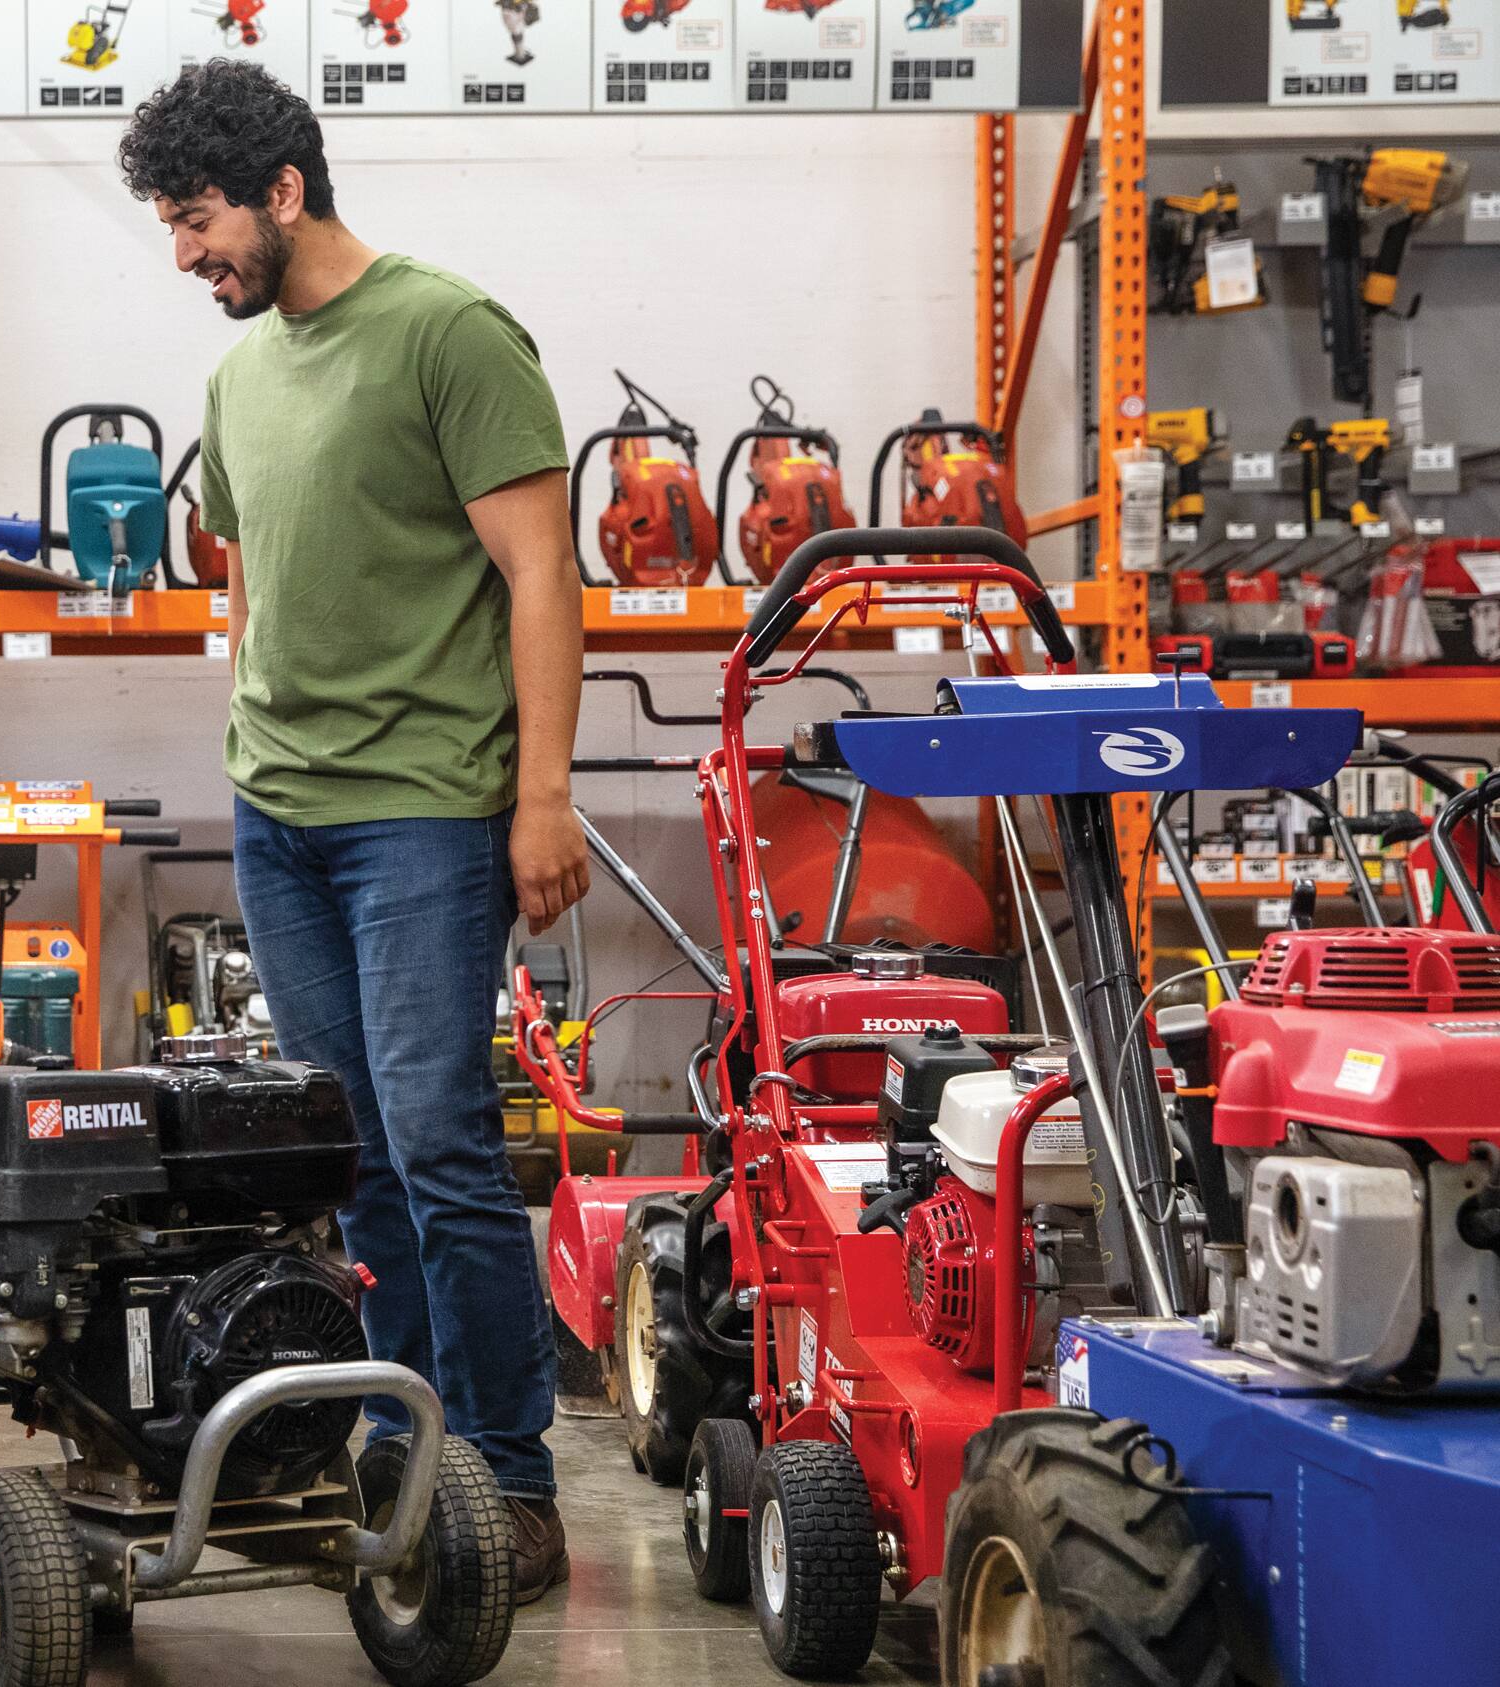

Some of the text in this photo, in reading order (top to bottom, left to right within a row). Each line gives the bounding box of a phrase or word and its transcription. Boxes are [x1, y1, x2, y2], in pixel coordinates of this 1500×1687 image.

[861, 1018, 964, 1032] HONDA
[63, 1102, 148, 1130] RENTAL
[272, 1350, 321, 1361] HONDA
[1067, 1383, 1087, 1409] USA
